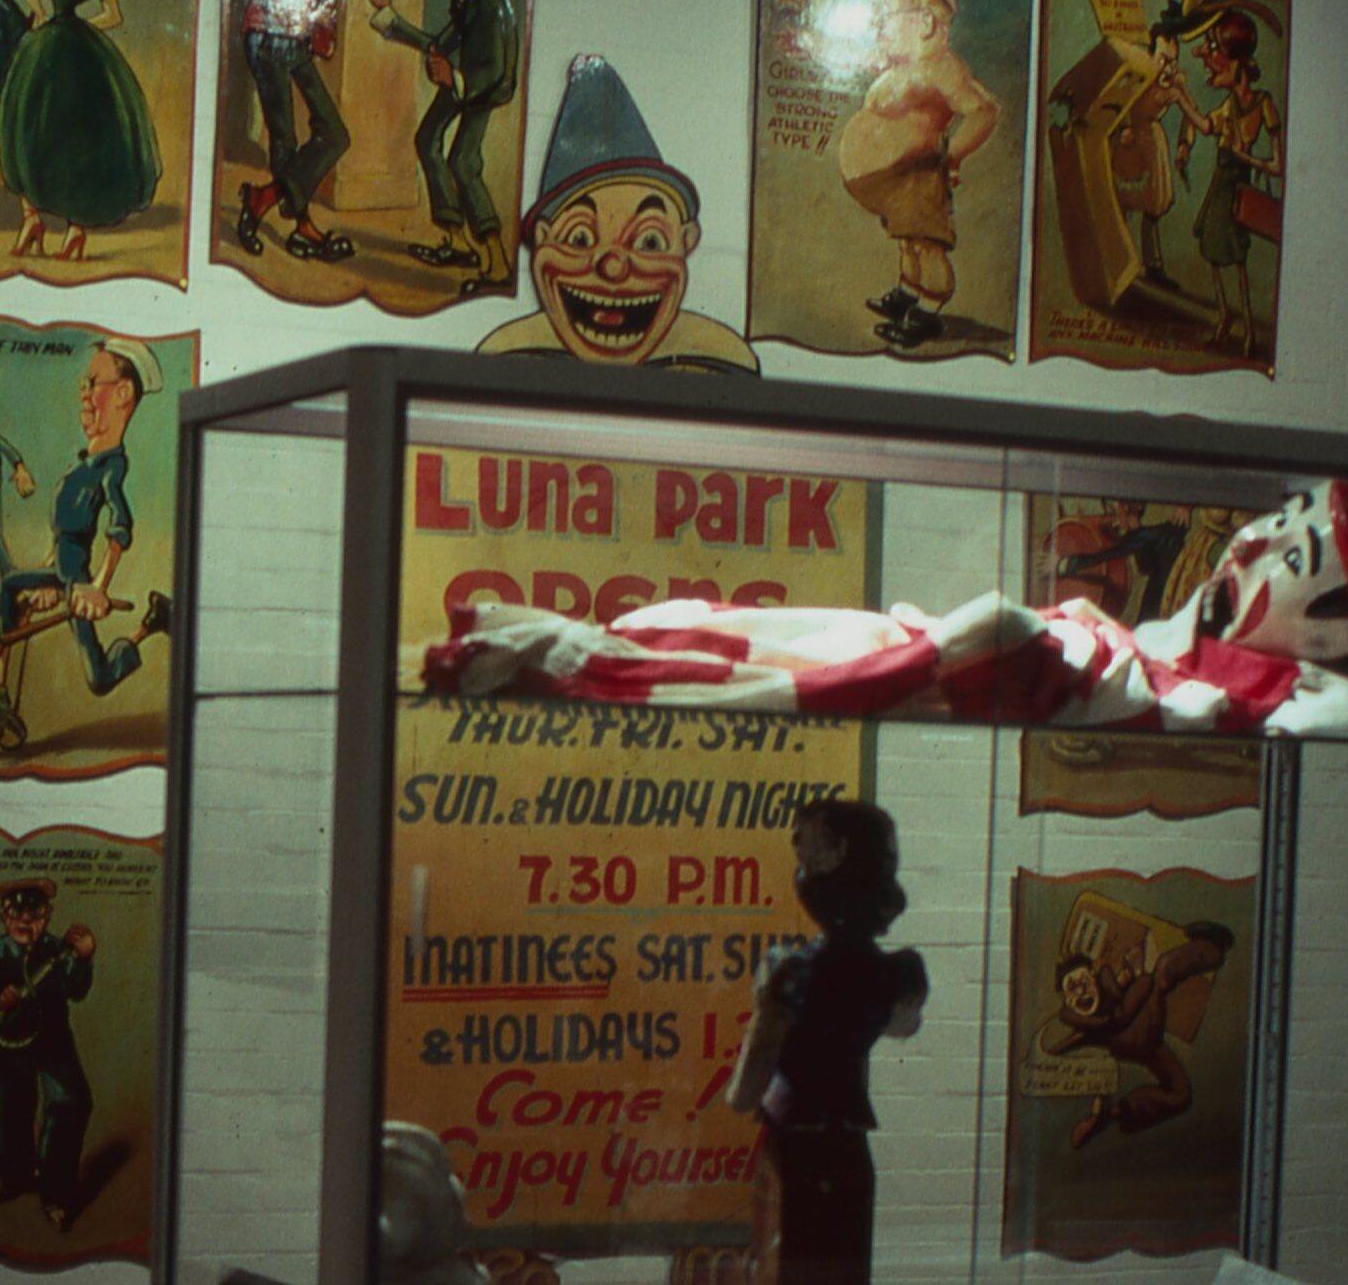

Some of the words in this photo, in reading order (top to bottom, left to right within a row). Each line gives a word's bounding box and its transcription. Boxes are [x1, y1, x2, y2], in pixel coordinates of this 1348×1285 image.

[767, 85, 821, 103] CHOOSE
[776, 102, 838, 120] STRONG
[768, 117, 834, 133] ATHLETIC
[773, 132, 810, 150] TYPE
[415, 453, 615, 537] Luna
[699, 715, 805, 753] SAT.
[398, 773, 502, 825] SUN.
[534, 776, 713, 829] HOLIDAY
[519, 855, 637, 905] 7.30
[666, 854, 774, 906] P.M.
[403, 934, 618, 986] MATINEES
[637, 933, 715, 983] SAT.
[456, 1012, 681, 1065] HOLIDAYS
[476, 1068, 664, 1128] Come
[602, 1124, 769, 1207] Yoursel
